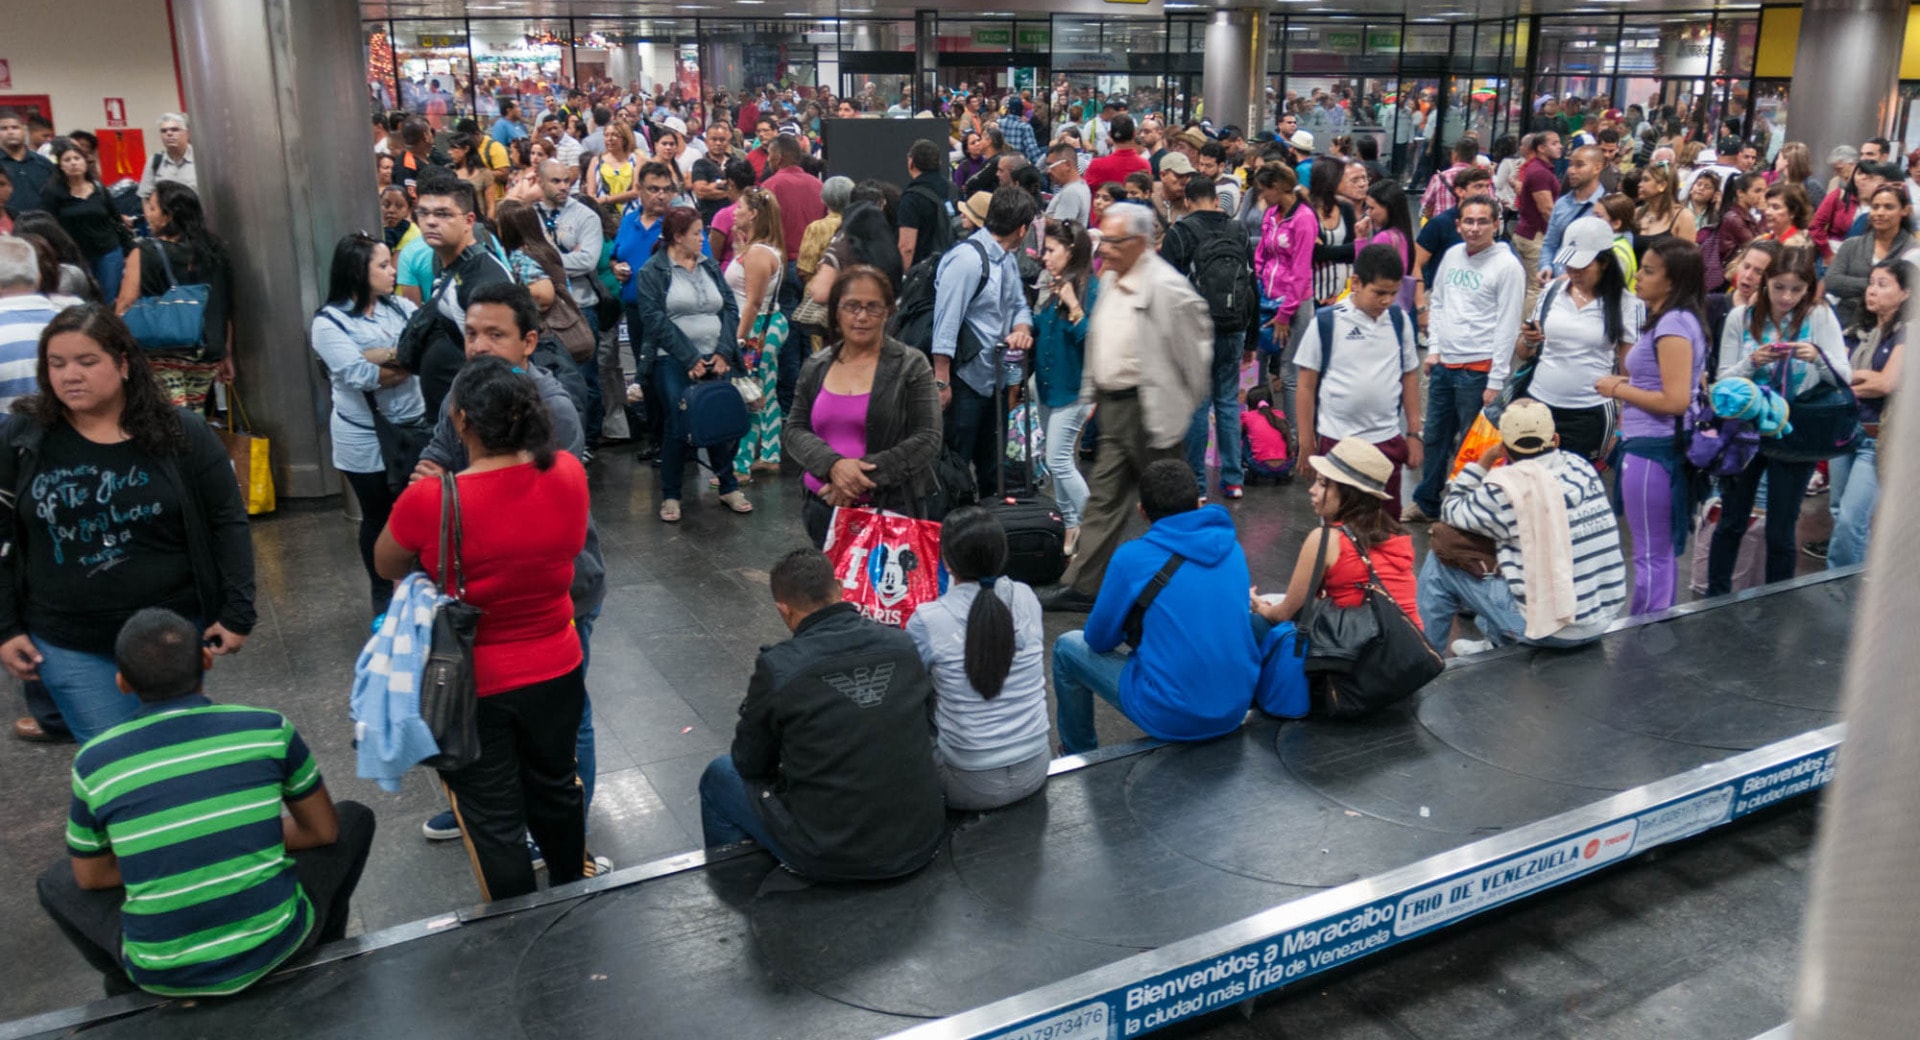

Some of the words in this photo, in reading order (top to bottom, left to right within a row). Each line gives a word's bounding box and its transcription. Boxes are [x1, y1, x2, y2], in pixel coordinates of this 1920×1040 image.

[1444, 267, 1483, 290] BOSS
[843, 546, 868, 589] I
[1741, 756, 1824, 795] Bienvenidos
[1401, 893, 1443, 921] FRIO
[1450, 880, 1475, 904] DE
[1481, 845, 1579, 892] VENEZUELA
[1125, 1018, 1141, 1035] la
[1144, 992, 1204, 1028] ciudad
[1206, 980, 1246, 1007] más
[1285, 959, 1308, 977] de
[1310, 929, 1391, 968] Venezuela
[1126, 951, 1259, 1012] Bienvenidos
[1263, 944, 1279, 963] a
[1281, 904, 1395, 957] Maracaibo
